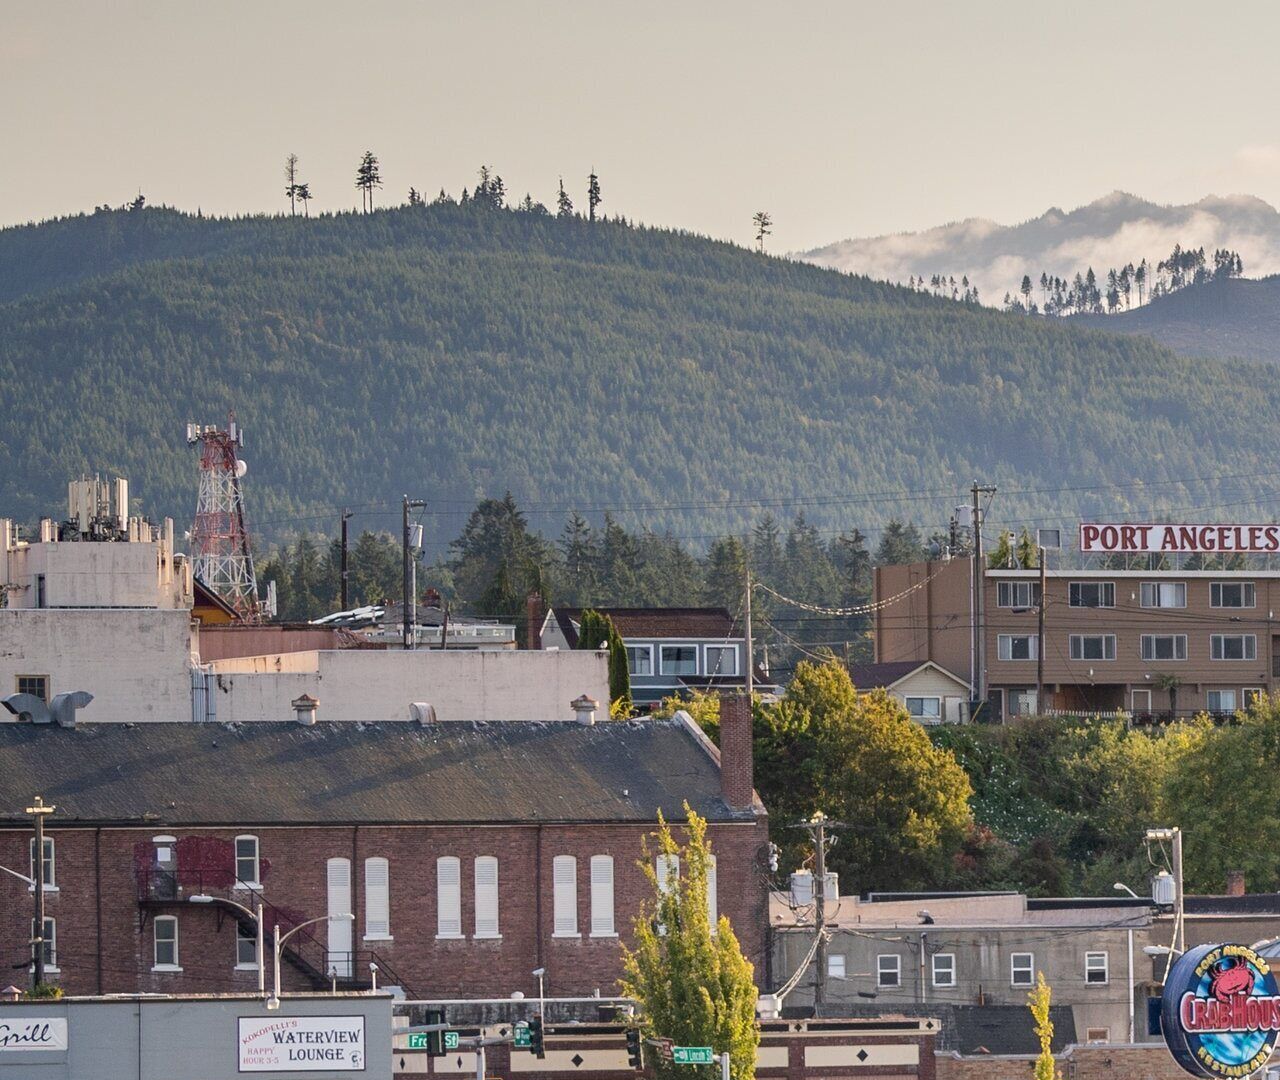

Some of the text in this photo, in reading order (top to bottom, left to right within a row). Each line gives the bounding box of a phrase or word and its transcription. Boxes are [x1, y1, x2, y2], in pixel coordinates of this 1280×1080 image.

[1083, 526, 1153, 550] PORT
[1161, 526, 1280, 550] ANGELES
[1195, 949, 1222, 978] PORT
[1222, 945, 1271, 976] ANGELES
[0, 1023, 52, 1046] Grill
[273, 1029, 361, 1044] WATERVIEW
[445, 1034, 457, 1046] St
[243, 1057, 265, 1065] HOUR
[247, 1047, 275, 1056] HAPPY
[288, 1048, 345, 1061] LOUNGE
[1197, 1043, 1273, 1077] RESTAURANT
